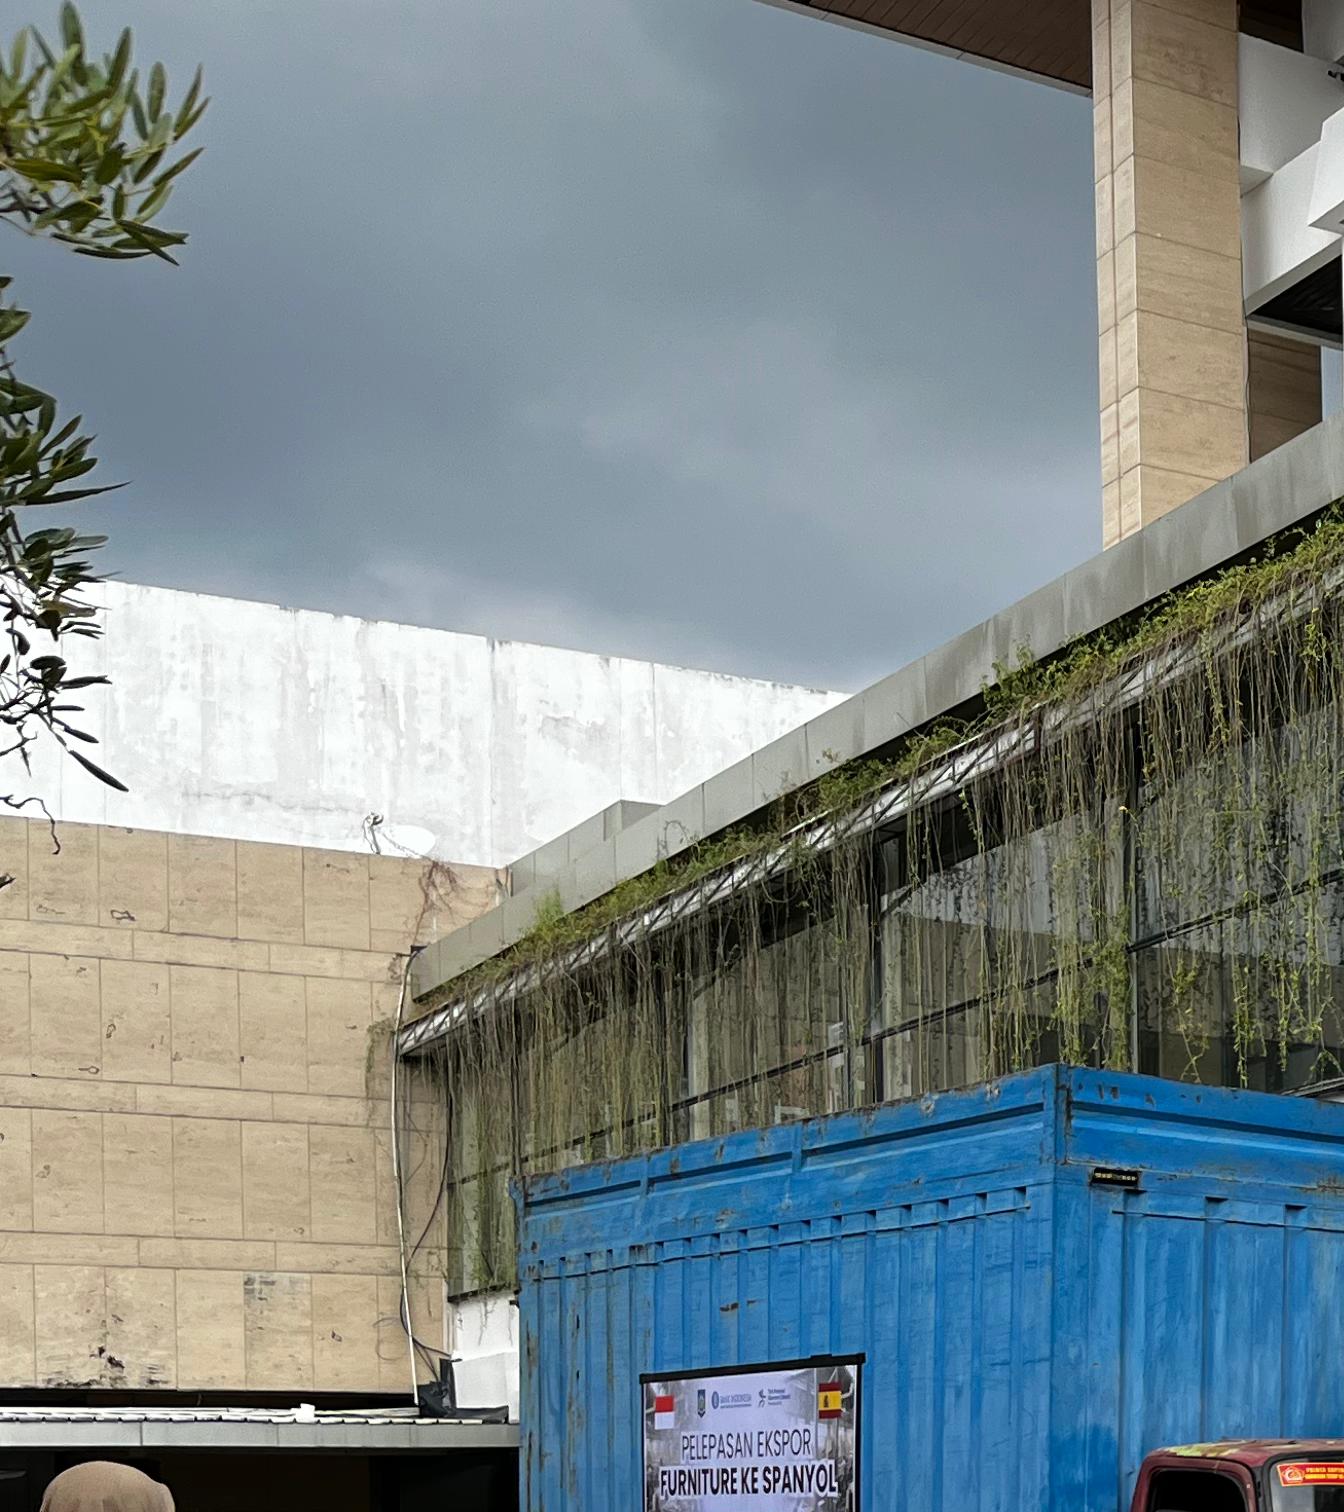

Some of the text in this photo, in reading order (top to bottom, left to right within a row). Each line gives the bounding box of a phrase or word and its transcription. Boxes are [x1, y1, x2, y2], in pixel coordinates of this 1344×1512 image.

[682, 1428, 811, 1461] PELEPASAN EKSPOR
[660, 1463, 837, 1497] FURNITURE KE SPANYOL
